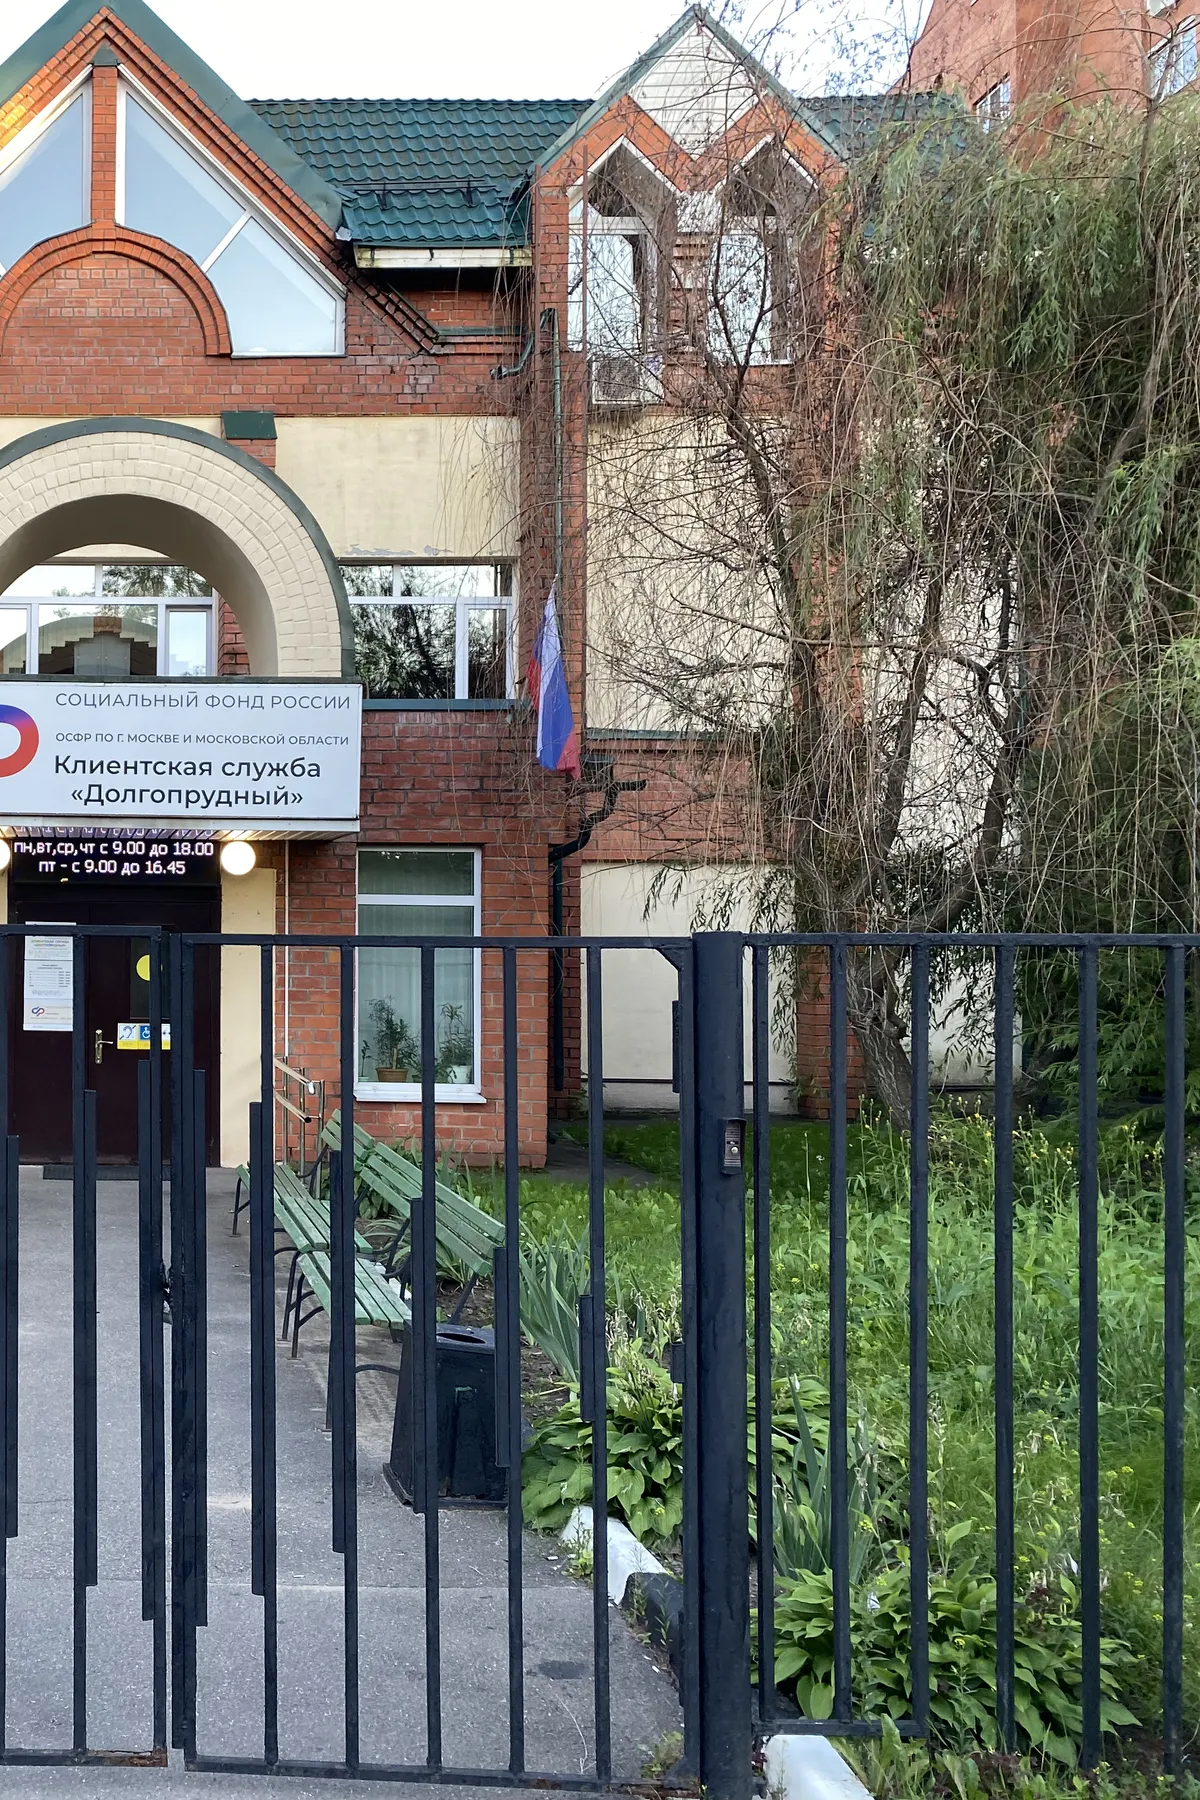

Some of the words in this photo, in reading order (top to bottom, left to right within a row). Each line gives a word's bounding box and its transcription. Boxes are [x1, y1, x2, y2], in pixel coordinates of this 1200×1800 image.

[55, 691, 198, 709] СОЦИАЛЬНЫЙ
[205, 694, 265, 710] ФОНД
[271, 695, 350, 710] РОССИИ
[55, 732, 92, 743] ОСФР
[95, 733, 114, 743] ПО
[127, 733, 180, 744] МОСКВЕ
[183, 734, 192, 743] И
[195, 733, 285, 745] МОСКОВСКОЙ
[288, 735, 349, 746] ОБЛАСТИ
[55, 755, 212, 776] Клиентская
[221, 756, 321, 782] служба
[71, 783, 303, 809] «Долгопрудный»
[99, 843, 109, 855] с
[112, 841, 146, 856] 9.00
[149, 845, 168, 858] до
[173, 842, 214, 856] 18.00
[38, 860, 57, 873] пт
[71, 861, 81, 873] с
[84, 859, 118, 874] 9.00
[121, 863, 140, 876] до
[145, 860, 186, 875] 16.45
